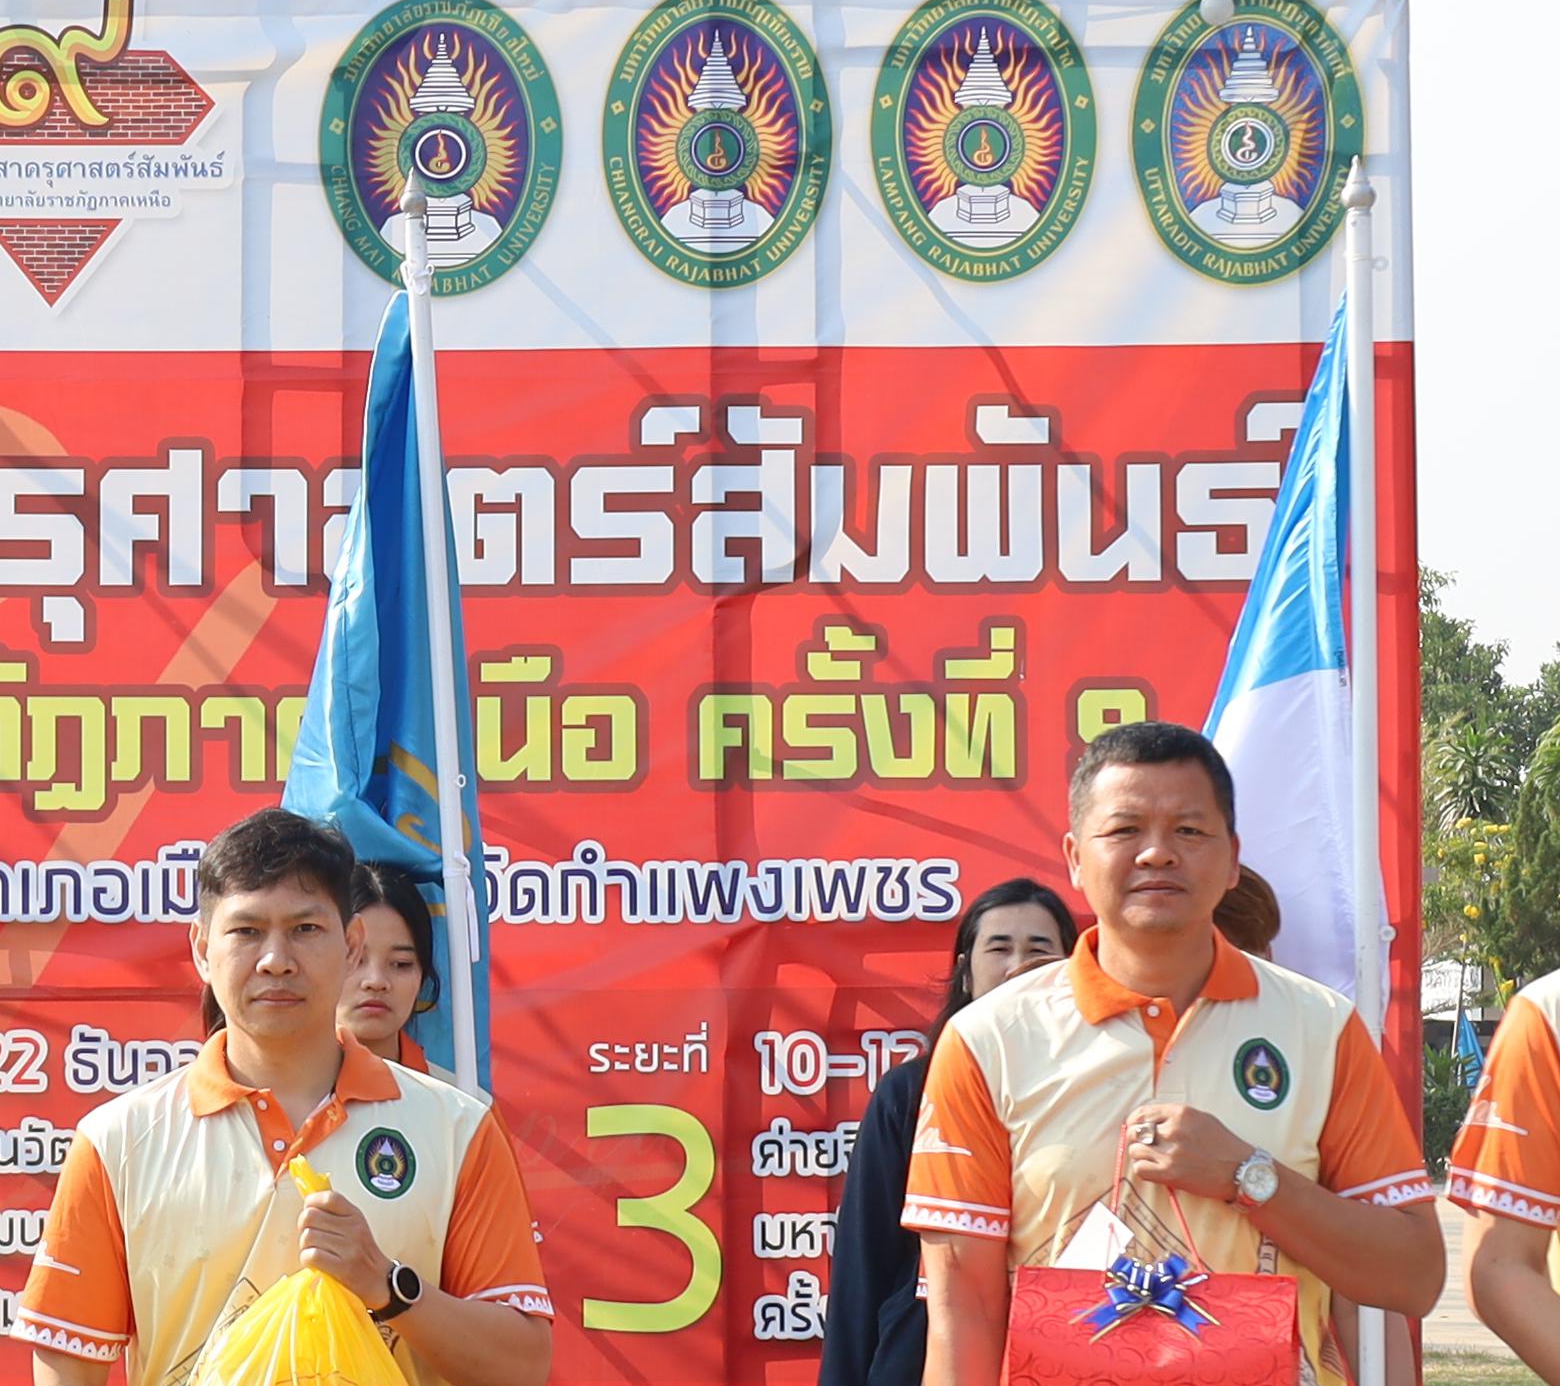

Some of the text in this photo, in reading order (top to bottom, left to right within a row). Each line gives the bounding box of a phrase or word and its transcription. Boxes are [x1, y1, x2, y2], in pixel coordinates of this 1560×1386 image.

[331, 165, 359, 235] CHIANG
[355, 236, 386, 266] MAI
[498, 161, 557, 264] UNIVERSITY
[610, 154, 823, 282] CHIANGRAI RAJABHAT UNIVERSITY
[879, 156, 1088, 277] LAMPANG RAJABHAT UNIVERSITY
[1144, 166, 1202, 265] UTTARADIT
[1202, 253, 1288, 279] RAJABHAT
[698, 625, 1017, 781] ครั้งที่
[588, 1021, 709, 1073] ระยะที่
[583, 1104, 722, 1333] 3
